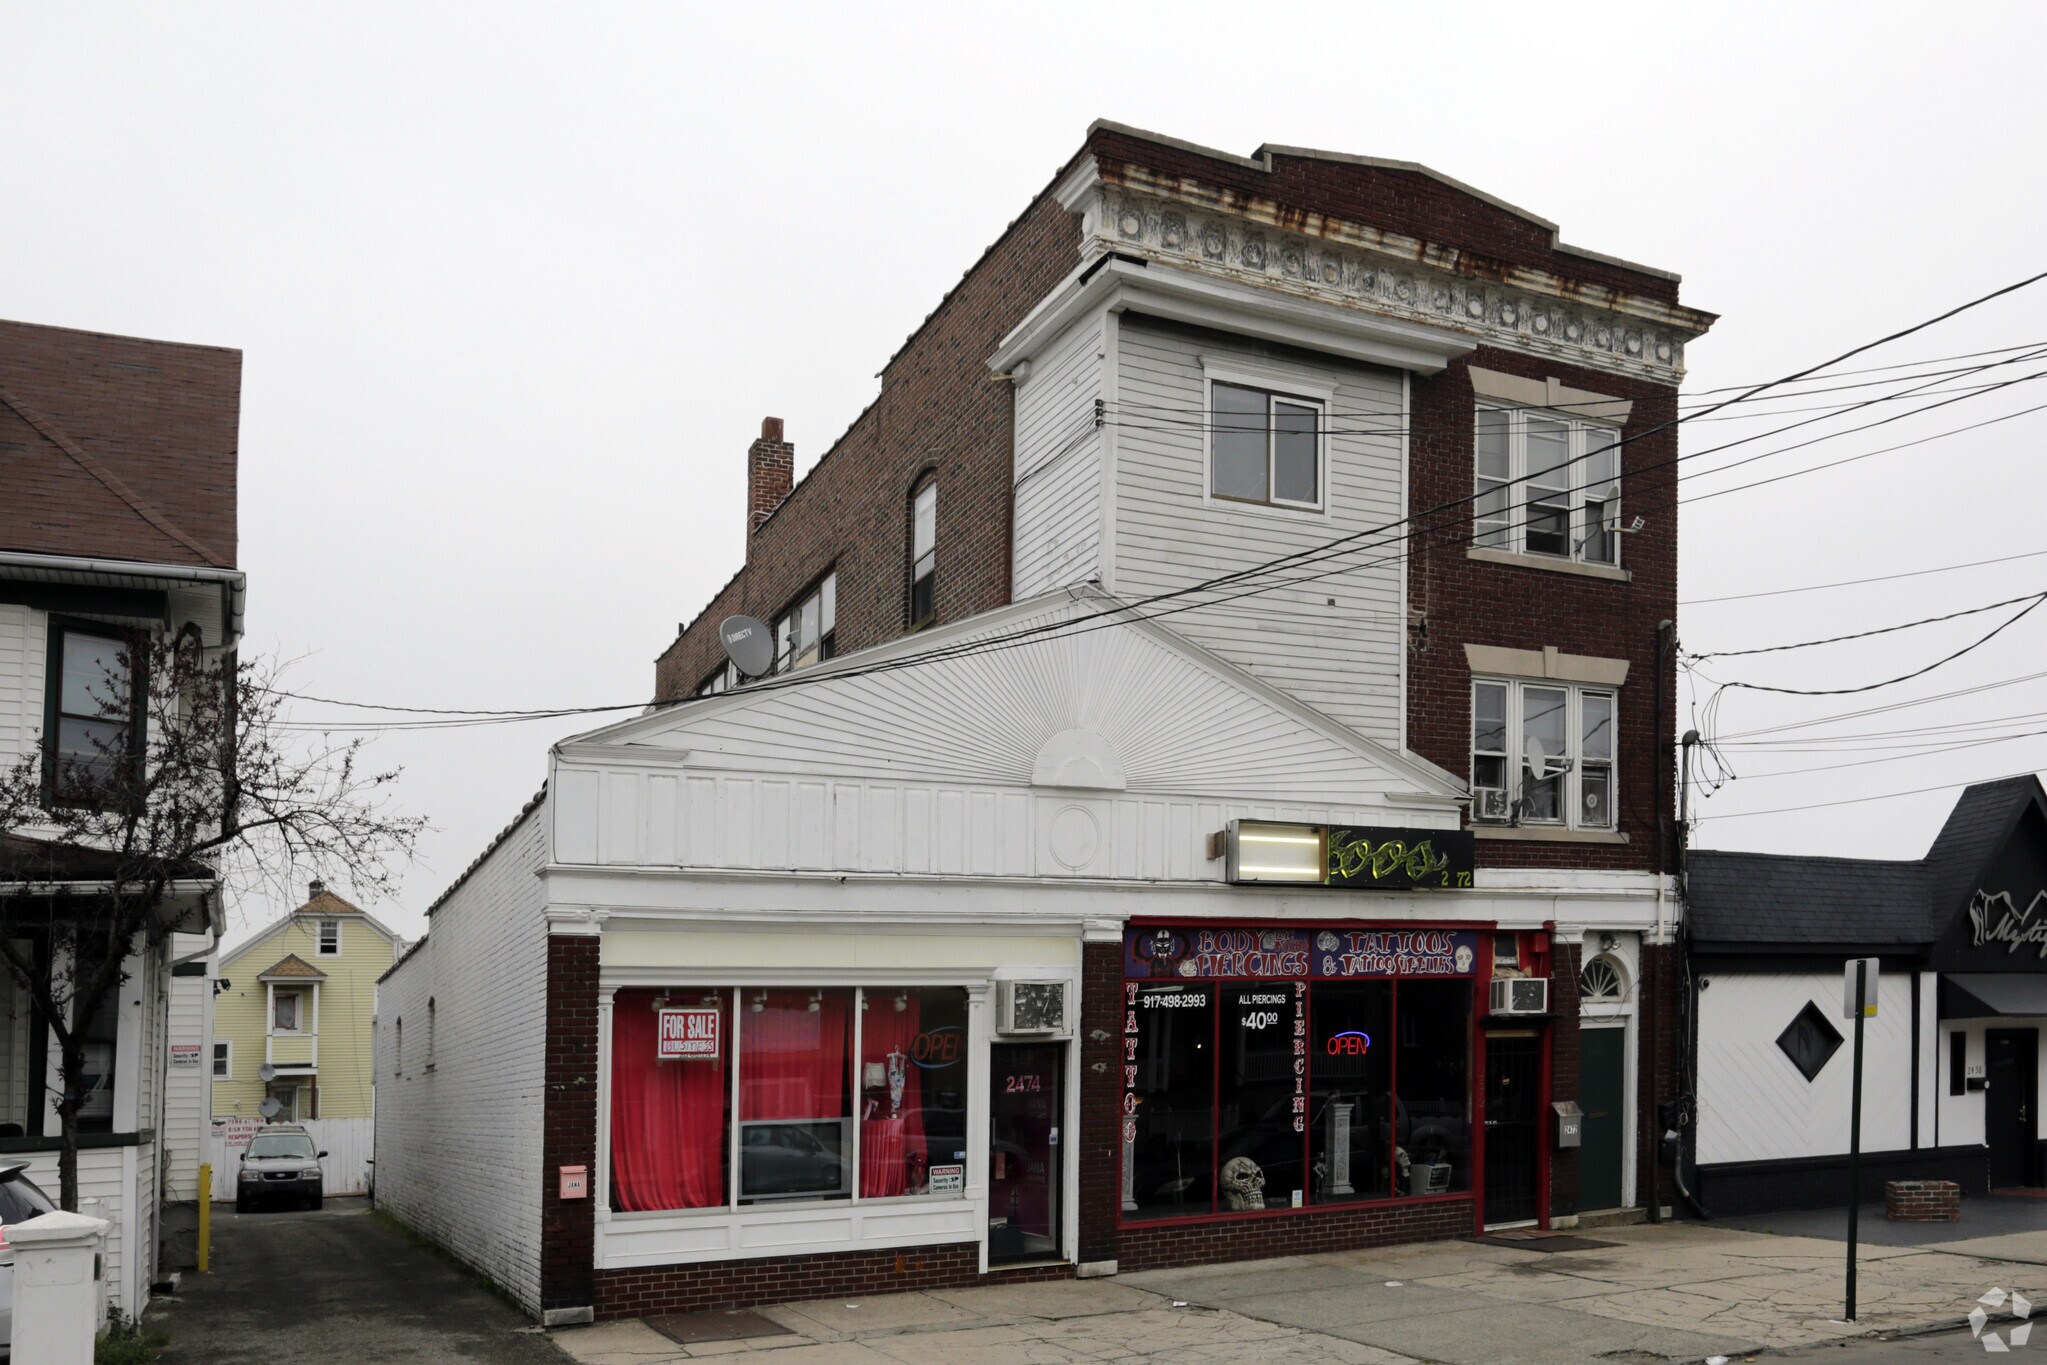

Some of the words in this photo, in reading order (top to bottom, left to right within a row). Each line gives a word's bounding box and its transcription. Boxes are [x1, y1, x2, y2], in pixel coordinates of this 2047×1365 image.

[731, 627, 752, 642] DIRECTV
[1198, 929, 1272, 952] BODY
[1344, 931, 1457, 955] TATTOOS
[1196, 951, 1309, 977] PIERCINGS
[1323, 955, 1337, 976] &
[1143, 994, 1206, 1009] 917-498-2993
[1239, 995, 1251, 1005] ALL
[1252, 994, 1286, 1005] PIERCINGS
[663, 1015, 684, 1039] FOR
[687, 1014, 715, 1039] SALE
[1293, 981, 1306, 1132] PIERCING
[1327, 1037, 1367, 1055] OPEN
[1006, 1075, 1041, 1093] 2474
